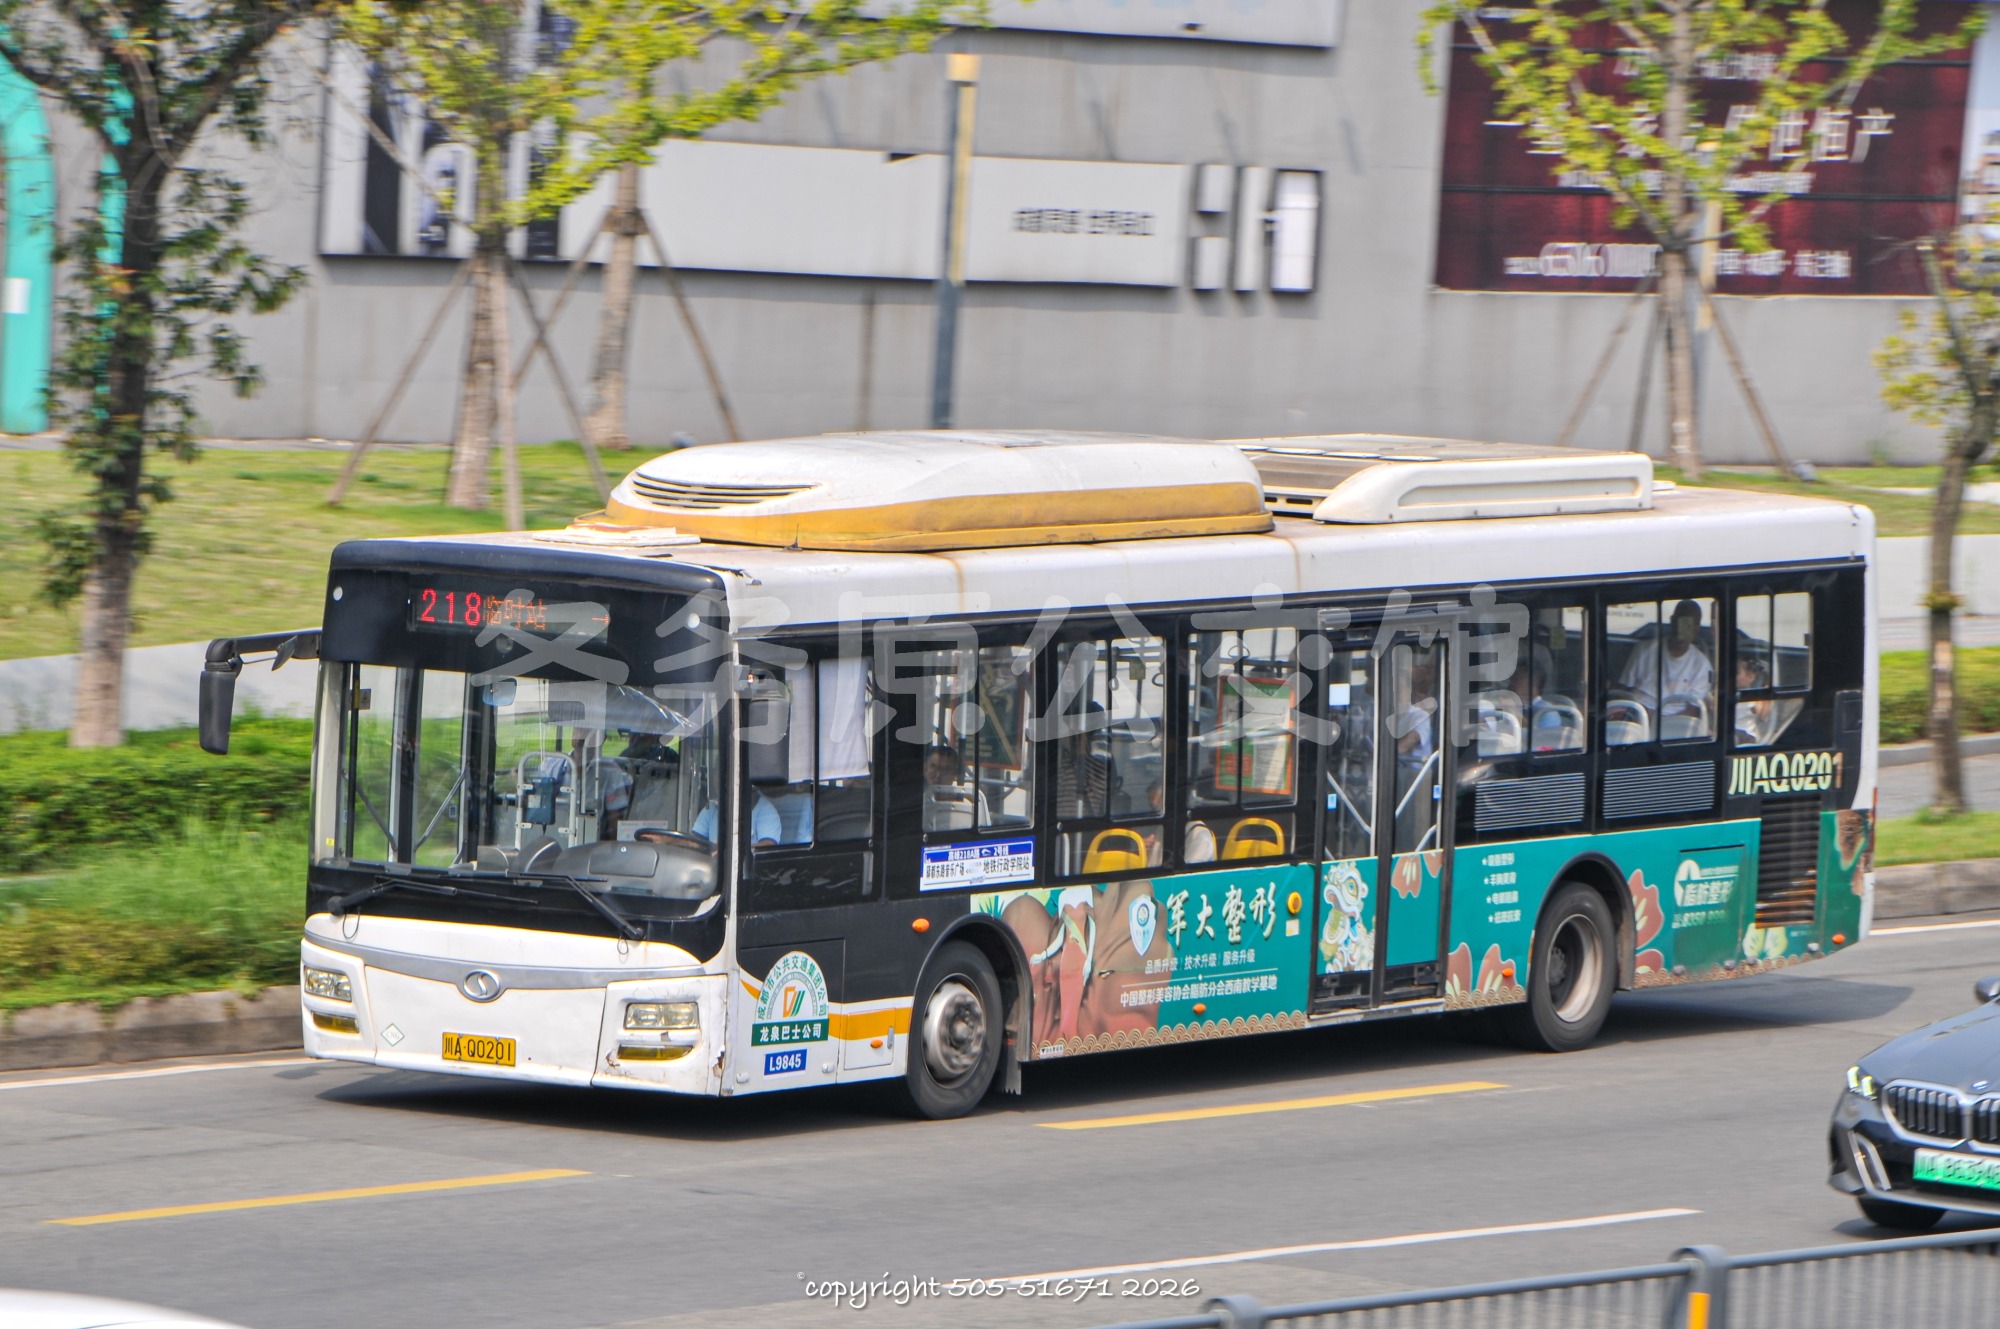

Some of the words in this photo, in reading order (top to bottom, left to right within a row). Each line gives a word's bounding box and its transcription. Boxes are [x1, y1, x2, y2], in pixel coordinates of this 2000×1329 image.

[420, 588, 482, 626] 218
[1728, 751, 1844, 795] 川AQ0201
[983, 856, 1030, 874] 地铁行政学院站
[1166, 881, 1278, 948] 军大整形
[757, 954, 828, 1020] 成都市公共交通集团公司
[760, 1023, 822, 1043] 龙泉巴士公司
[769, 1053, 802, 1072] L9845
